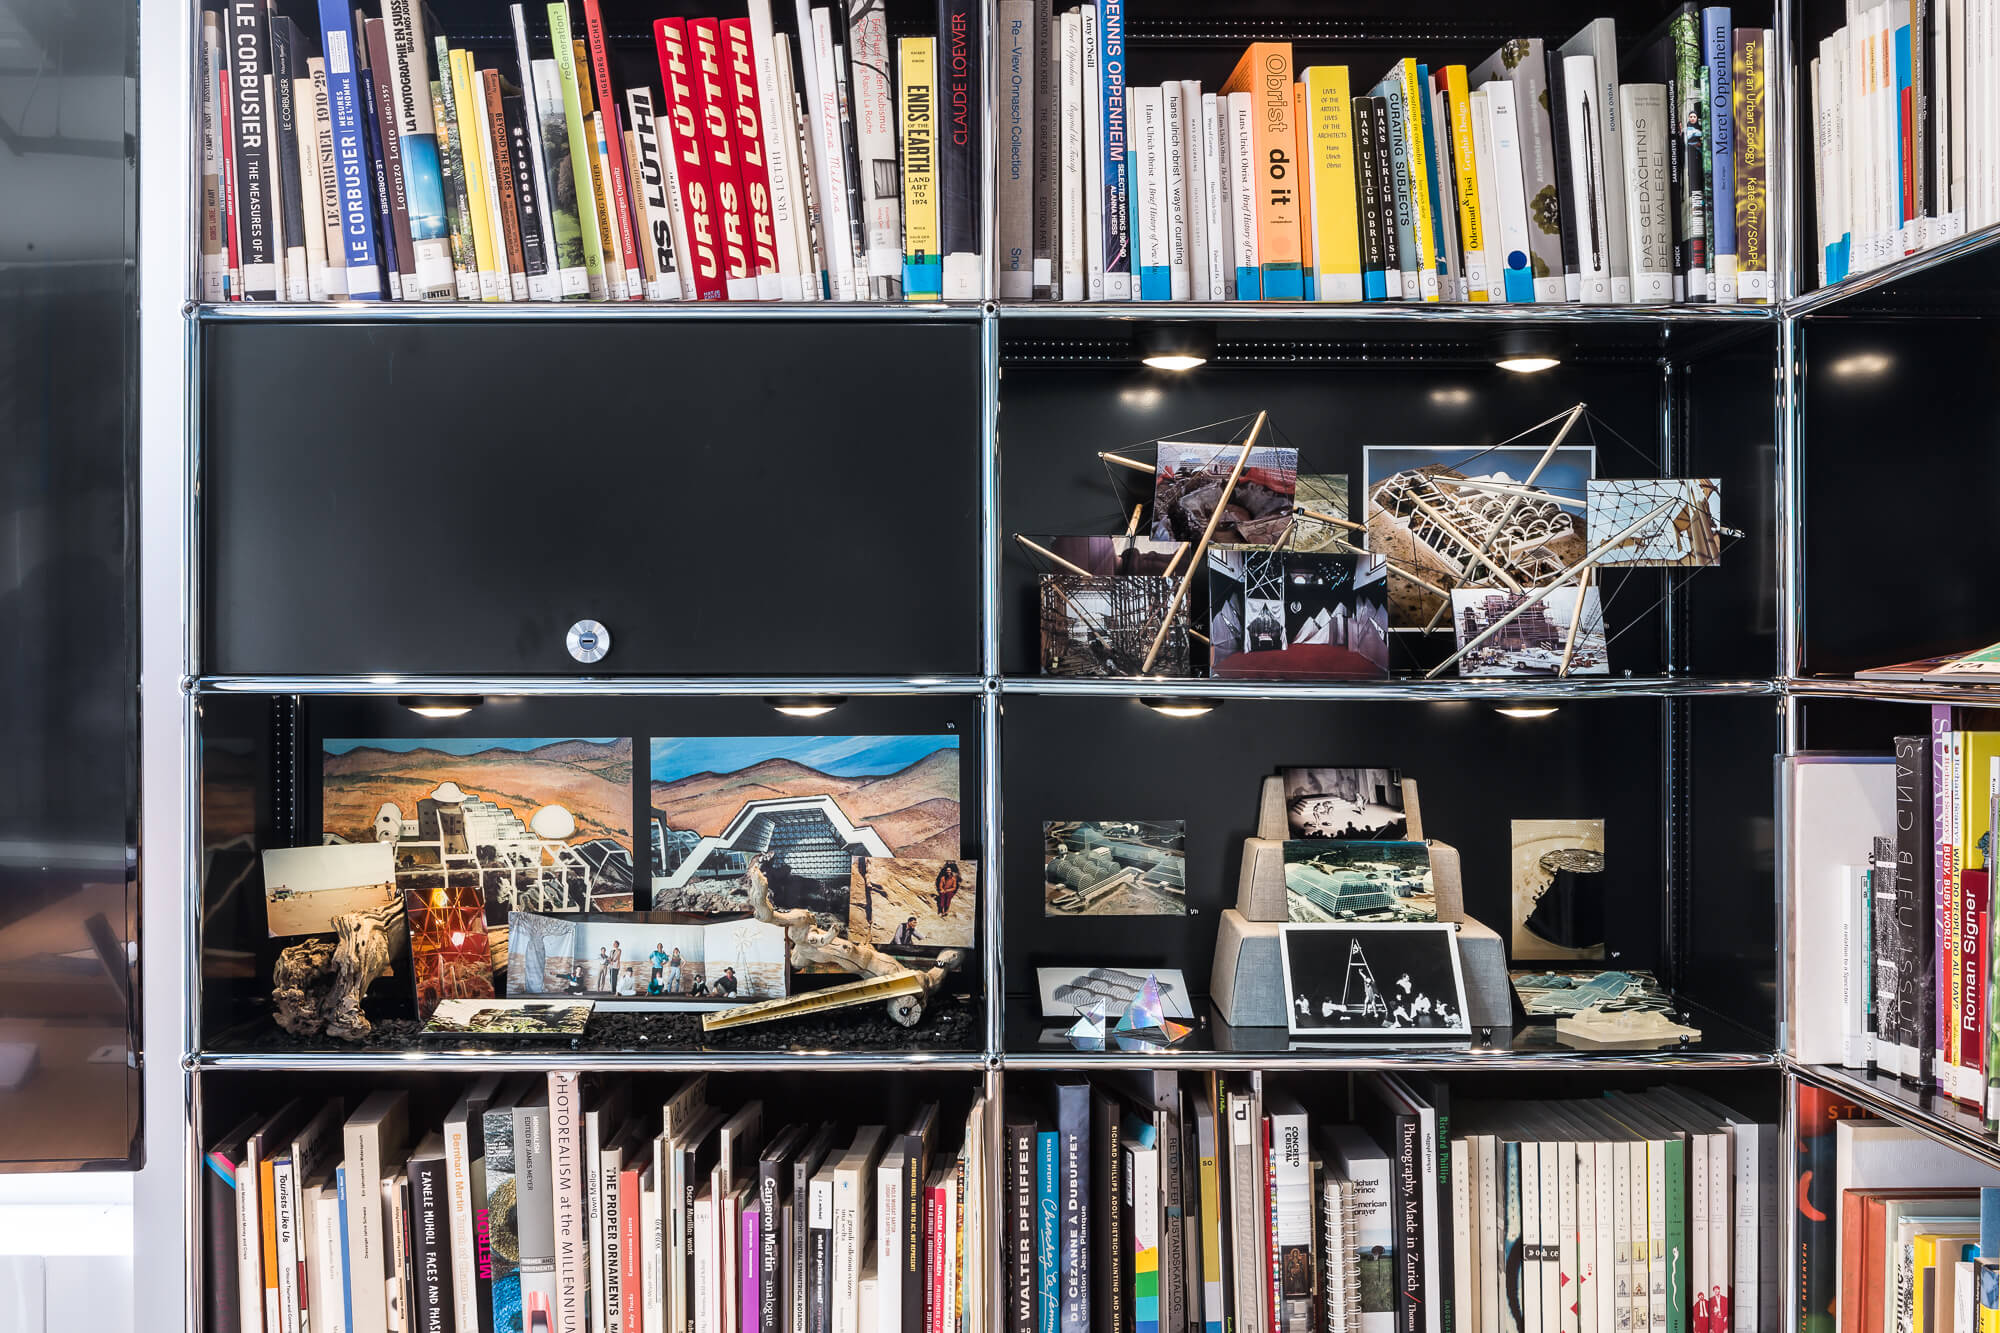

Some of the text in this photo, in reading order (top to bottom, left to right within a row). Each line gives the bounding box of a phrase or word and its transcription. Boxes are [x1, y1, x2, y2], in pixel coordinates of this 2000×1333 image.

[591, 18, 608, 97] INGEBORG LÜSCHER
[1086, 16, 1094, 36] Amy
[236, 3, 260, 148] LE CORBUSIER
[336, 90, 346, 126] MESURES
[664, 24, 701, 166] LÜTHI
[907, 86, 929, 121] ENDS
[952, 12, 968, 146] CLAUDE LOEWER
[1107, 60, 1124, 162] OPPENHEIM
[1608, 108, 1616, 132] ROMAN
[1716, 26, 1732, 156] Meret Oppenheim
[312, 70, 340, 227] LE CORBUSIER 1910-29
[382, 84, 406, 210] Lorenzo Lotto 1480-1557
[496, 113, 507, 148] BEYOND
[499, 150, 508, 166] THE
[696, 26, 746, 278] URS LÜTHI
[729, 26, 776, 274] URS LÜTHI
[908, 129, 930, 173] EARTH
[1266, 54, 1291, 206] Obrist do it
[1390, 92, 1410, 226] CURATING SUBJECTS
[1744, 40, 1758, 265] Toward an Urban Ecology Kate Orff/SCAPE
[248, 161, 262, 251] THE MEASURES OF
[340, 136, 368, 262] LE CORBUSIER
[376, 160, 388, 214] LE CORBUSIER
[501, 168, 512, 190] STARS
[613, 166, 632, 254] Kunstsammlungen Chemnitz
[1118, 164, 1126, 202] SELECTED
[1118, 204, 1126, 230] WORKS
[1170, 96, 1184, 264] hans ulrich obrist ways of curating
[1360, 110, 1378, 263] HANS ULRICH OBRIST
[1377, 108, 1396, 262] HANS ULRICH OBRIST
[1654, 152, 1668, 268] DER MALEREI
[688, 182, 716, 278] URS
[1943, 845, 1952, 950] BUSY, BUSY WORLD
[1952, 848, 1960, 1009] WHAT DO PEOPLE DO ALL DAY?
[1963, 890, 1978, 1032] Roman Signer
[452, 1132, 463, 1177] Bernhard
[526, 1169, 534, 1190] MEYER
[1292, 1126, 1300, 1167] CONCRETO
[1439, 1116, 1449, 1184] Richard Phillips
[280, 1174, 290, 1243] Tourists Like Us
[455, 1180, 464, 1212] Martin
[590, 1196, 598, 1218] Dawn
[606, 1167, 618, 1316] THE PROPER ORNAMENTS
[686, 1185, 694, 1206] Oscar
[686, 1208, 694, 1235] Murillo:
[1019, 1138, 1030, 1321] WALTER PFEIFFER
[1080, 1206, 1088, 1252] Planque
[1400, 1122, 1420, 1332] Photography, Made in Zurich Thomas
[476, 1208, 492, 1279] METRON
[764, 1178, 776, 1326] Cameron Martin analogue
